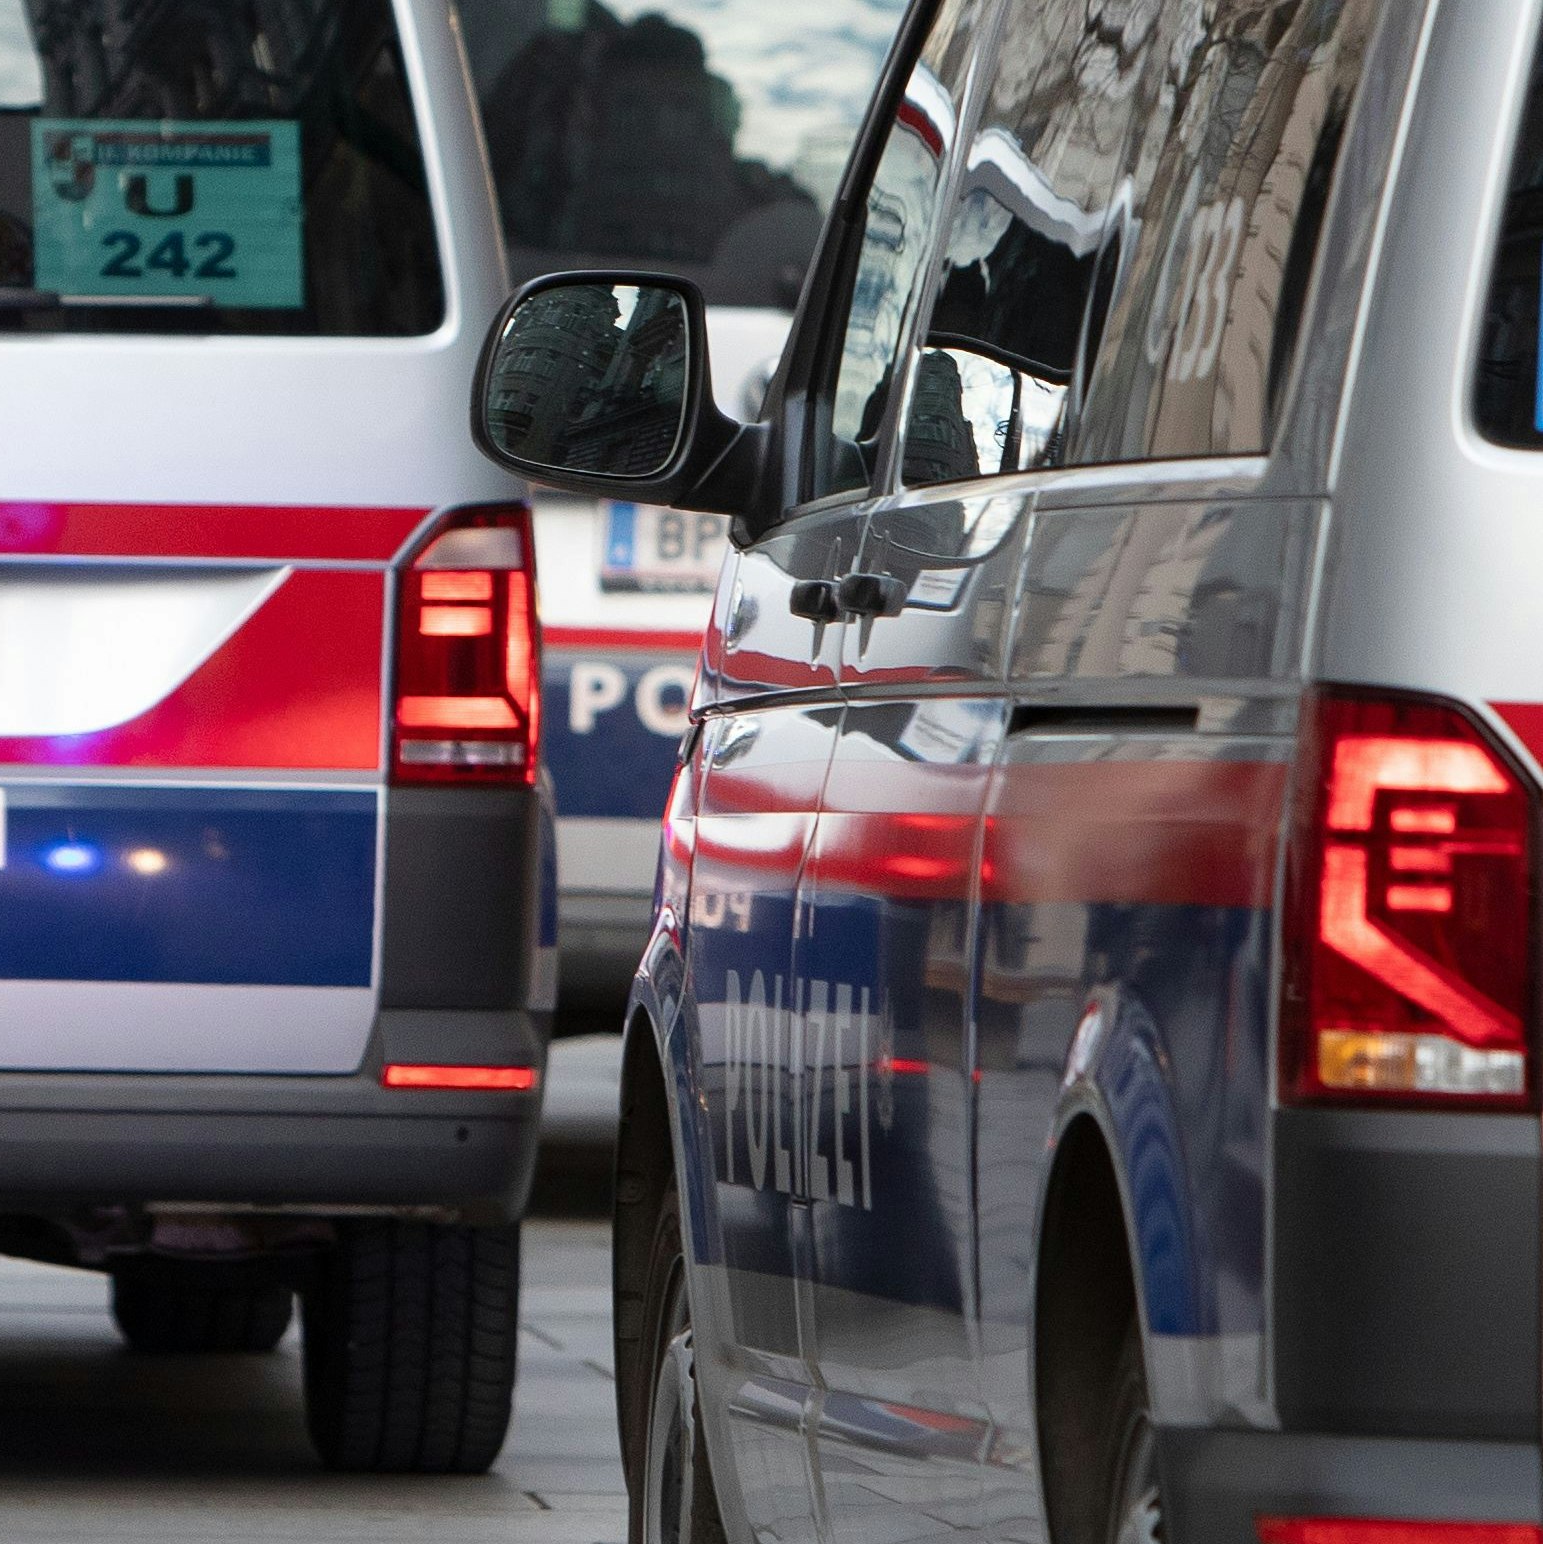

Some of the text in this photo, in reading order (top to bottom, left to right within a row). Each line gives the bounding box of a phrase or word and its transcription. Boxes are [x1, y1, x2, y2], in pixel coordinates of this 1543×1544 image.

[127, 144, 257, 162] KOMPANIE
[125, 173, 194, 216] U
[99, 231, 237, 279] 242
[657, 511, 723, 561] BP
[725, 968, 872, 1211] POLIZEI
